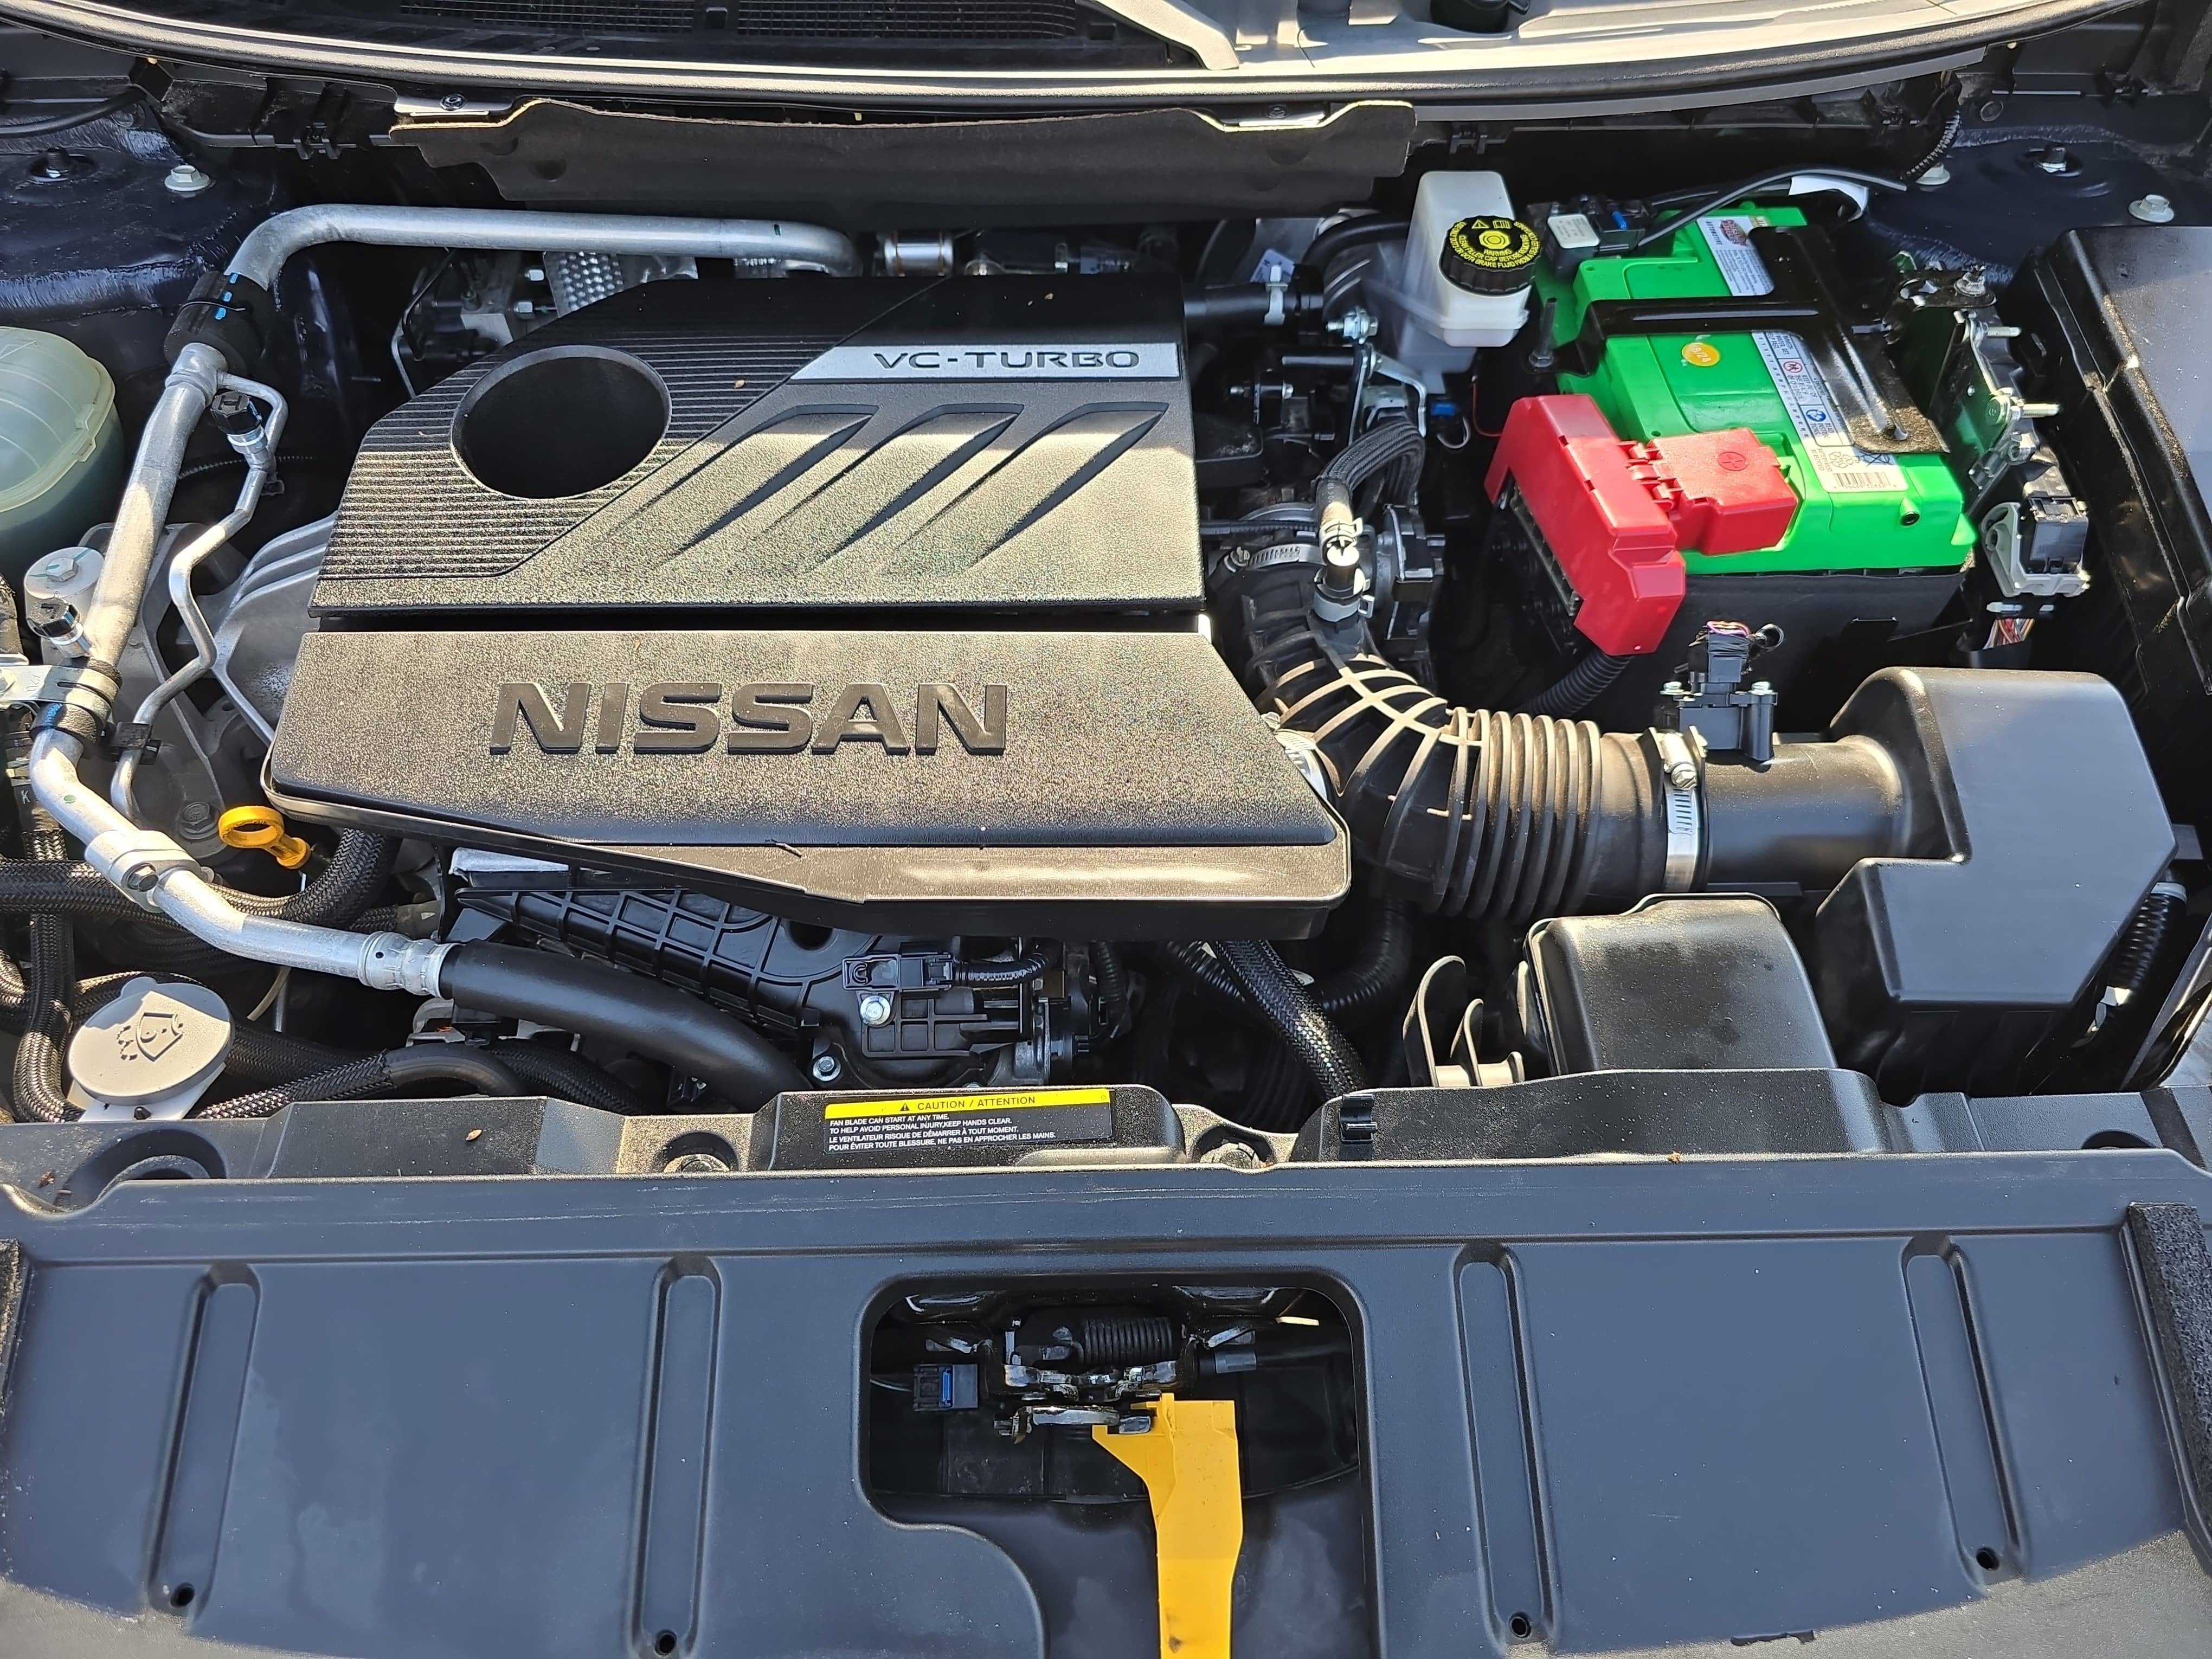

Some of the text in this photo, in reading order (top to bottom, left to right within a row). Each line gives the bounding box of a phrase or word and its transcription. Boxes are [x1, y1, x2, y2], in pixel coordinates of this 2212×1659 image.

[1475, 259, 1496, 267] BRAKE
[1499, 252, 1522, 261] BEFORE
[873, 351, 1139, 369] VC-TURBO
[218, 395, 242, 410] H
[490, 683, 1007, 755] NISSAN
[22, 790, 30, 804] K
[917, 1099, 965, 1110] CAUTION
[978, 1096, 1035, 1107] ATTENTION
[882, 1123, 919, 1131] PERSONAL
[839, 1134, 883, 1142] VENTILATEUR
[923, 1129, 961, 1137] DÉMARRER
[850, 1142, 874, 1150] ÉVITER
[898, 1139, 936, 1147] BLESSURE,
[974, 1134, 1017, 1142] APPROCHER
